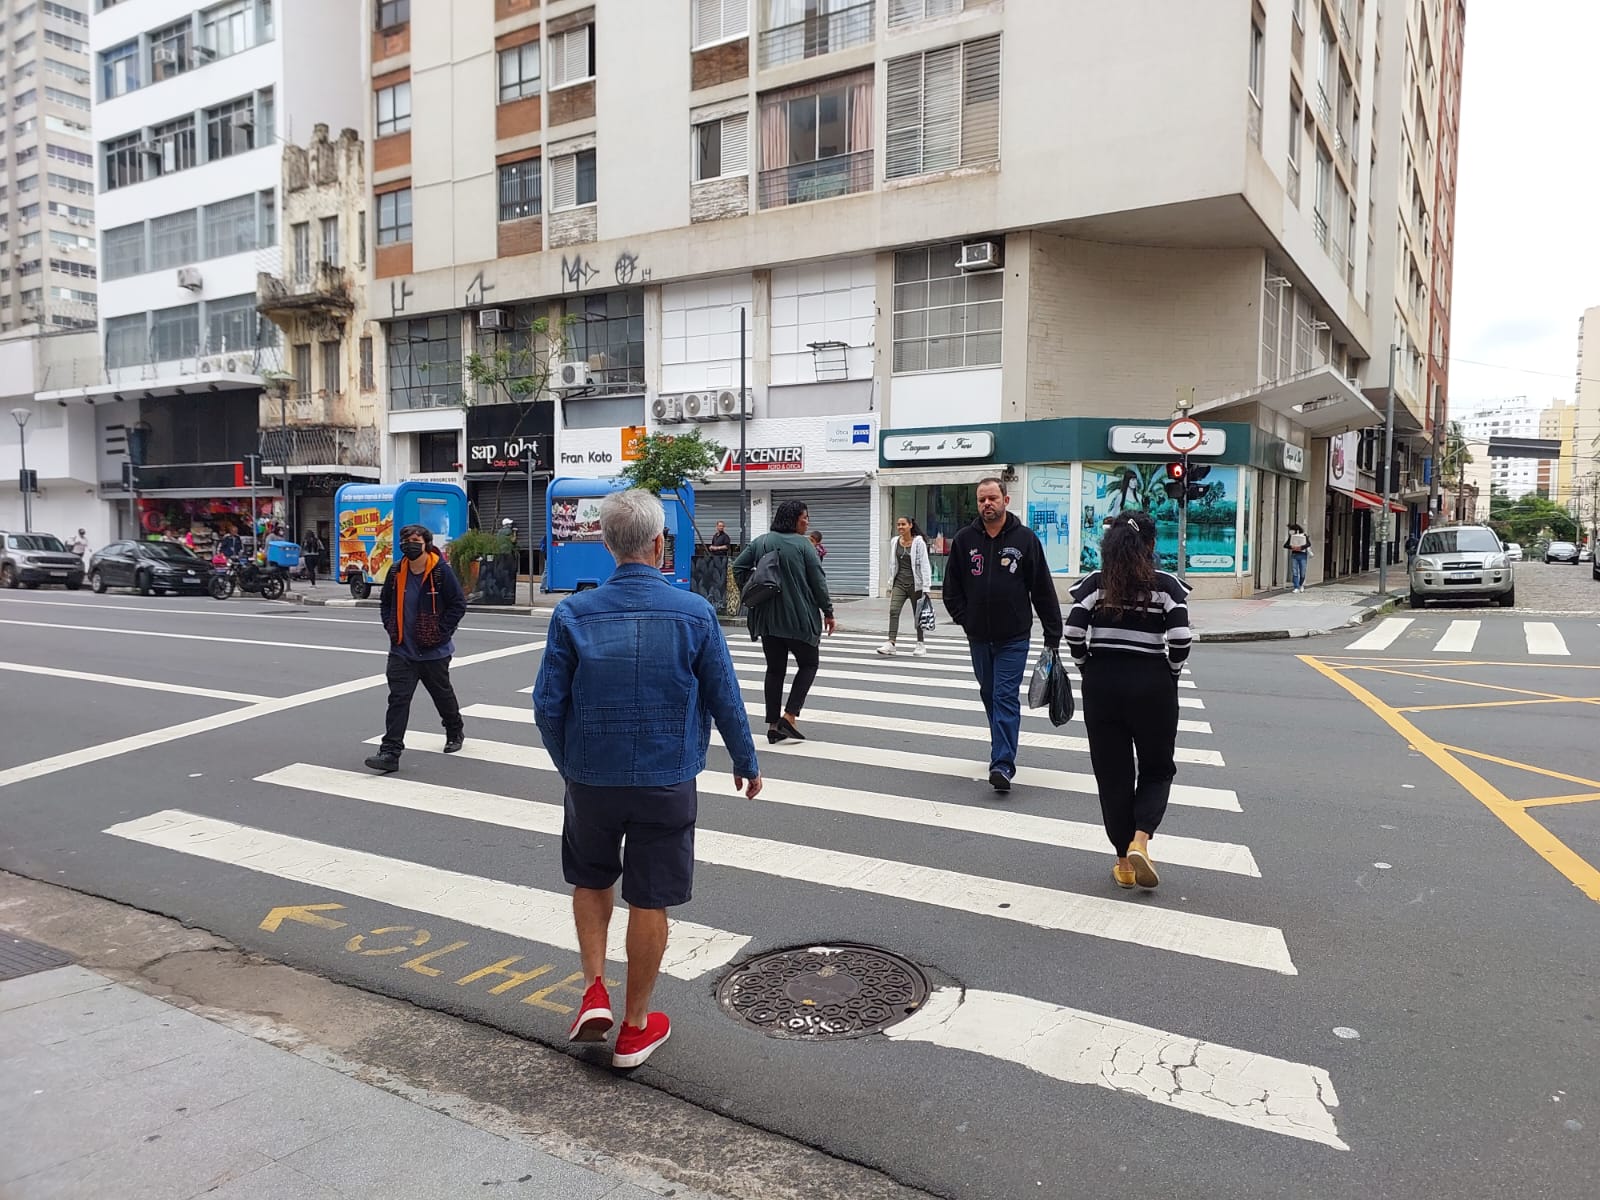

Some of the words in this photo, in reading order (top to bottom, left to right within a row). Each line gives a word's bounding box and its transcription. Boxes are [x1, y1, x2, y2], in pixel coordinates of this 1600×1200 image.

[561, 452, 584, 464] Fran
[588, 450, 613, 463] Koto
[971, 554, 984, 576] 3
[345, 926, 620, 1014] OLHE
